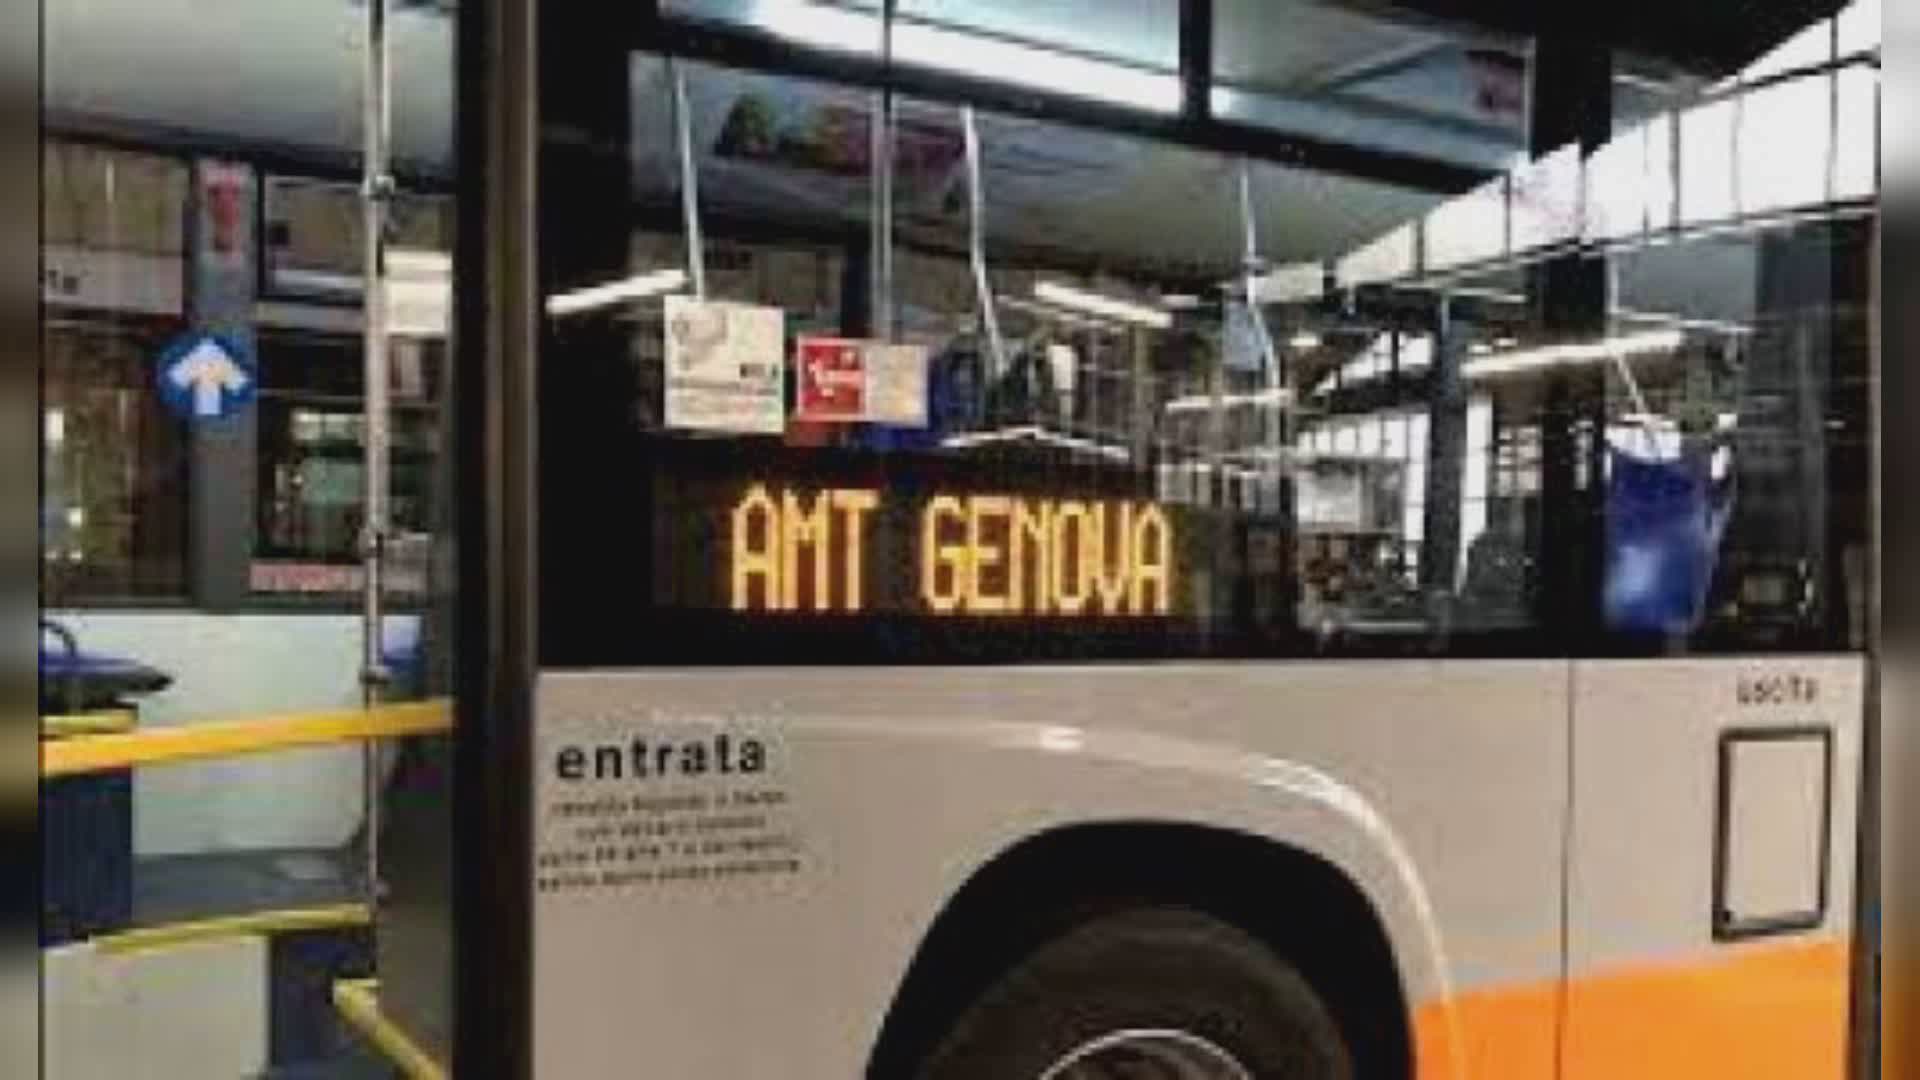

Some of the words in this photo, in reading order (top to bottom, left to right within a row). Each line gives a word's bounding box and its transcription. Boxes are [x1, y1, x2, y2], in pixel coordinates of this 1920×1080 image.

[732, 485, 878, 611] AMT
[924, 495, 1172, 615] GENOVA
[556, 733, 766, 780] entrata
